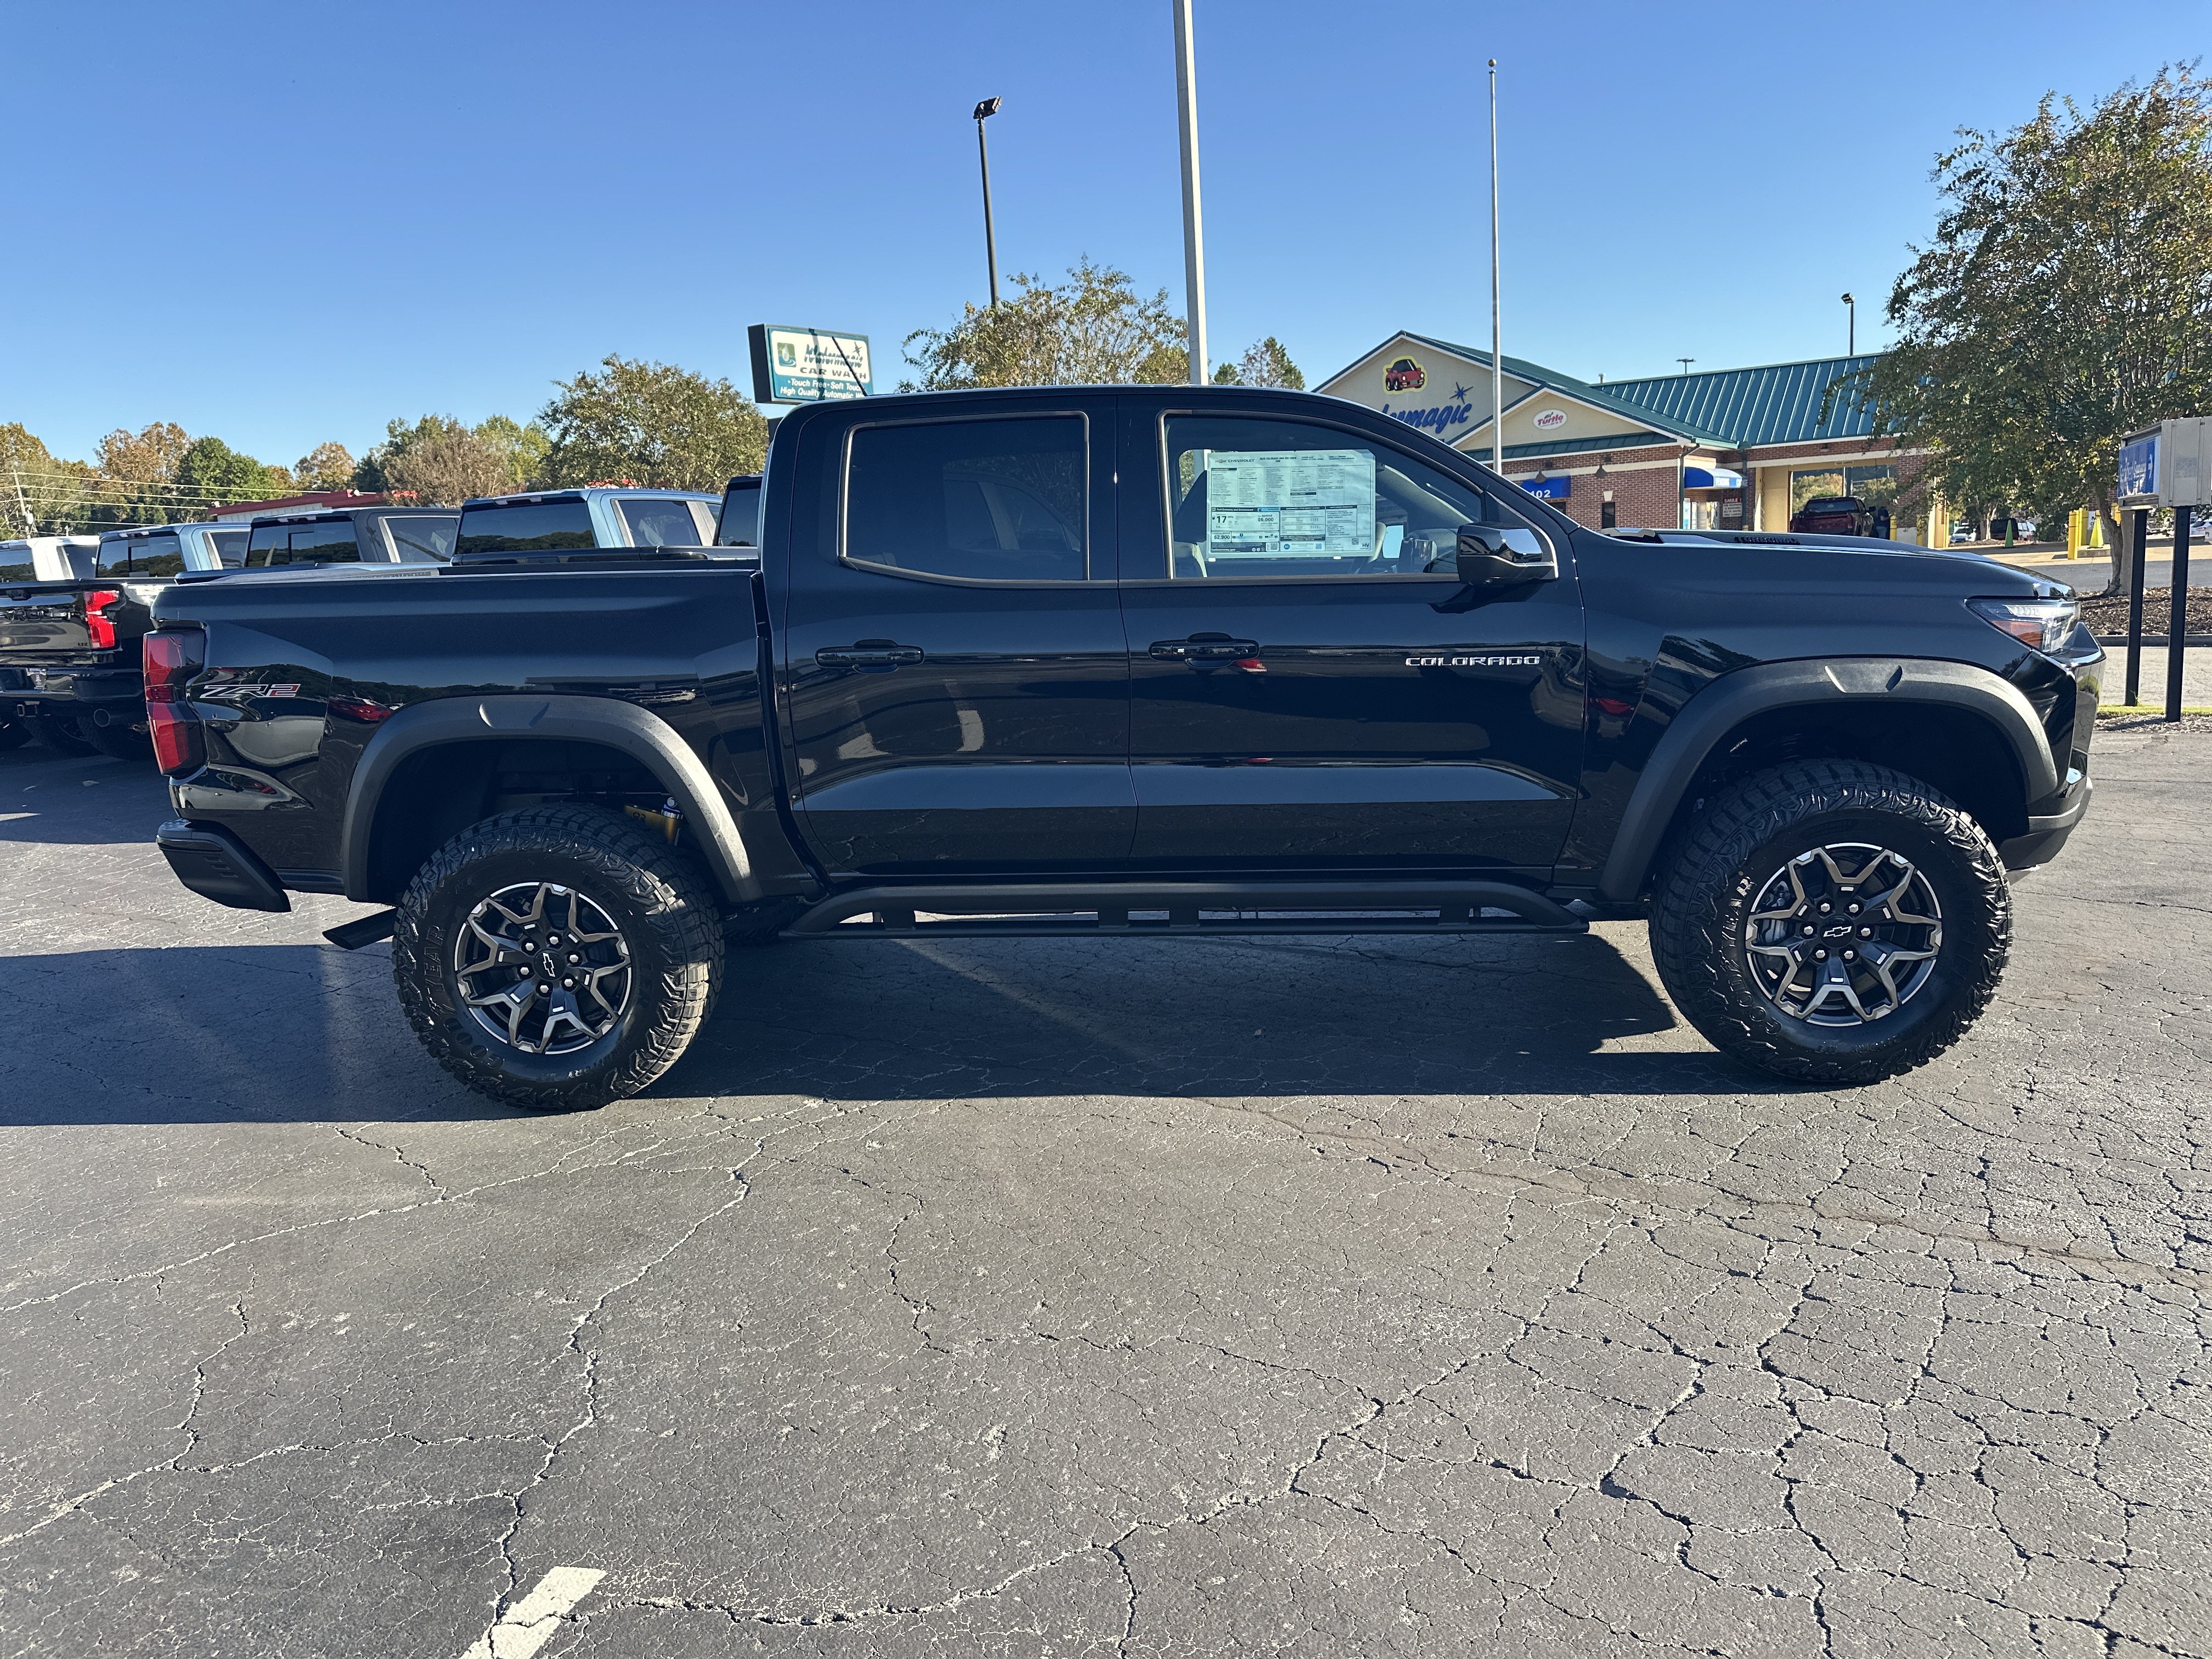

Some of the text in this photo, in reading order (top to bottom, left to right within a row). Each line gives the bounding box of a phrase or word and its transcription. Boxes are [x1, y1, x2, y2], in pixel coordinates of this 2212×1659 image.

[800, 367, 866, 379] CAR WAH
[791, 378, 861, 391] Touch Free Soft Touc
[780, 386, 795, 396] High
[798, 387, 820, 398] Quality
[823, 390, 854, 399] Automatic
[1537, 414, 1564, 426] Turtle
[1405, 656, 1541, 666] COLORADO
[200, 684, 301, 698] ZR2
